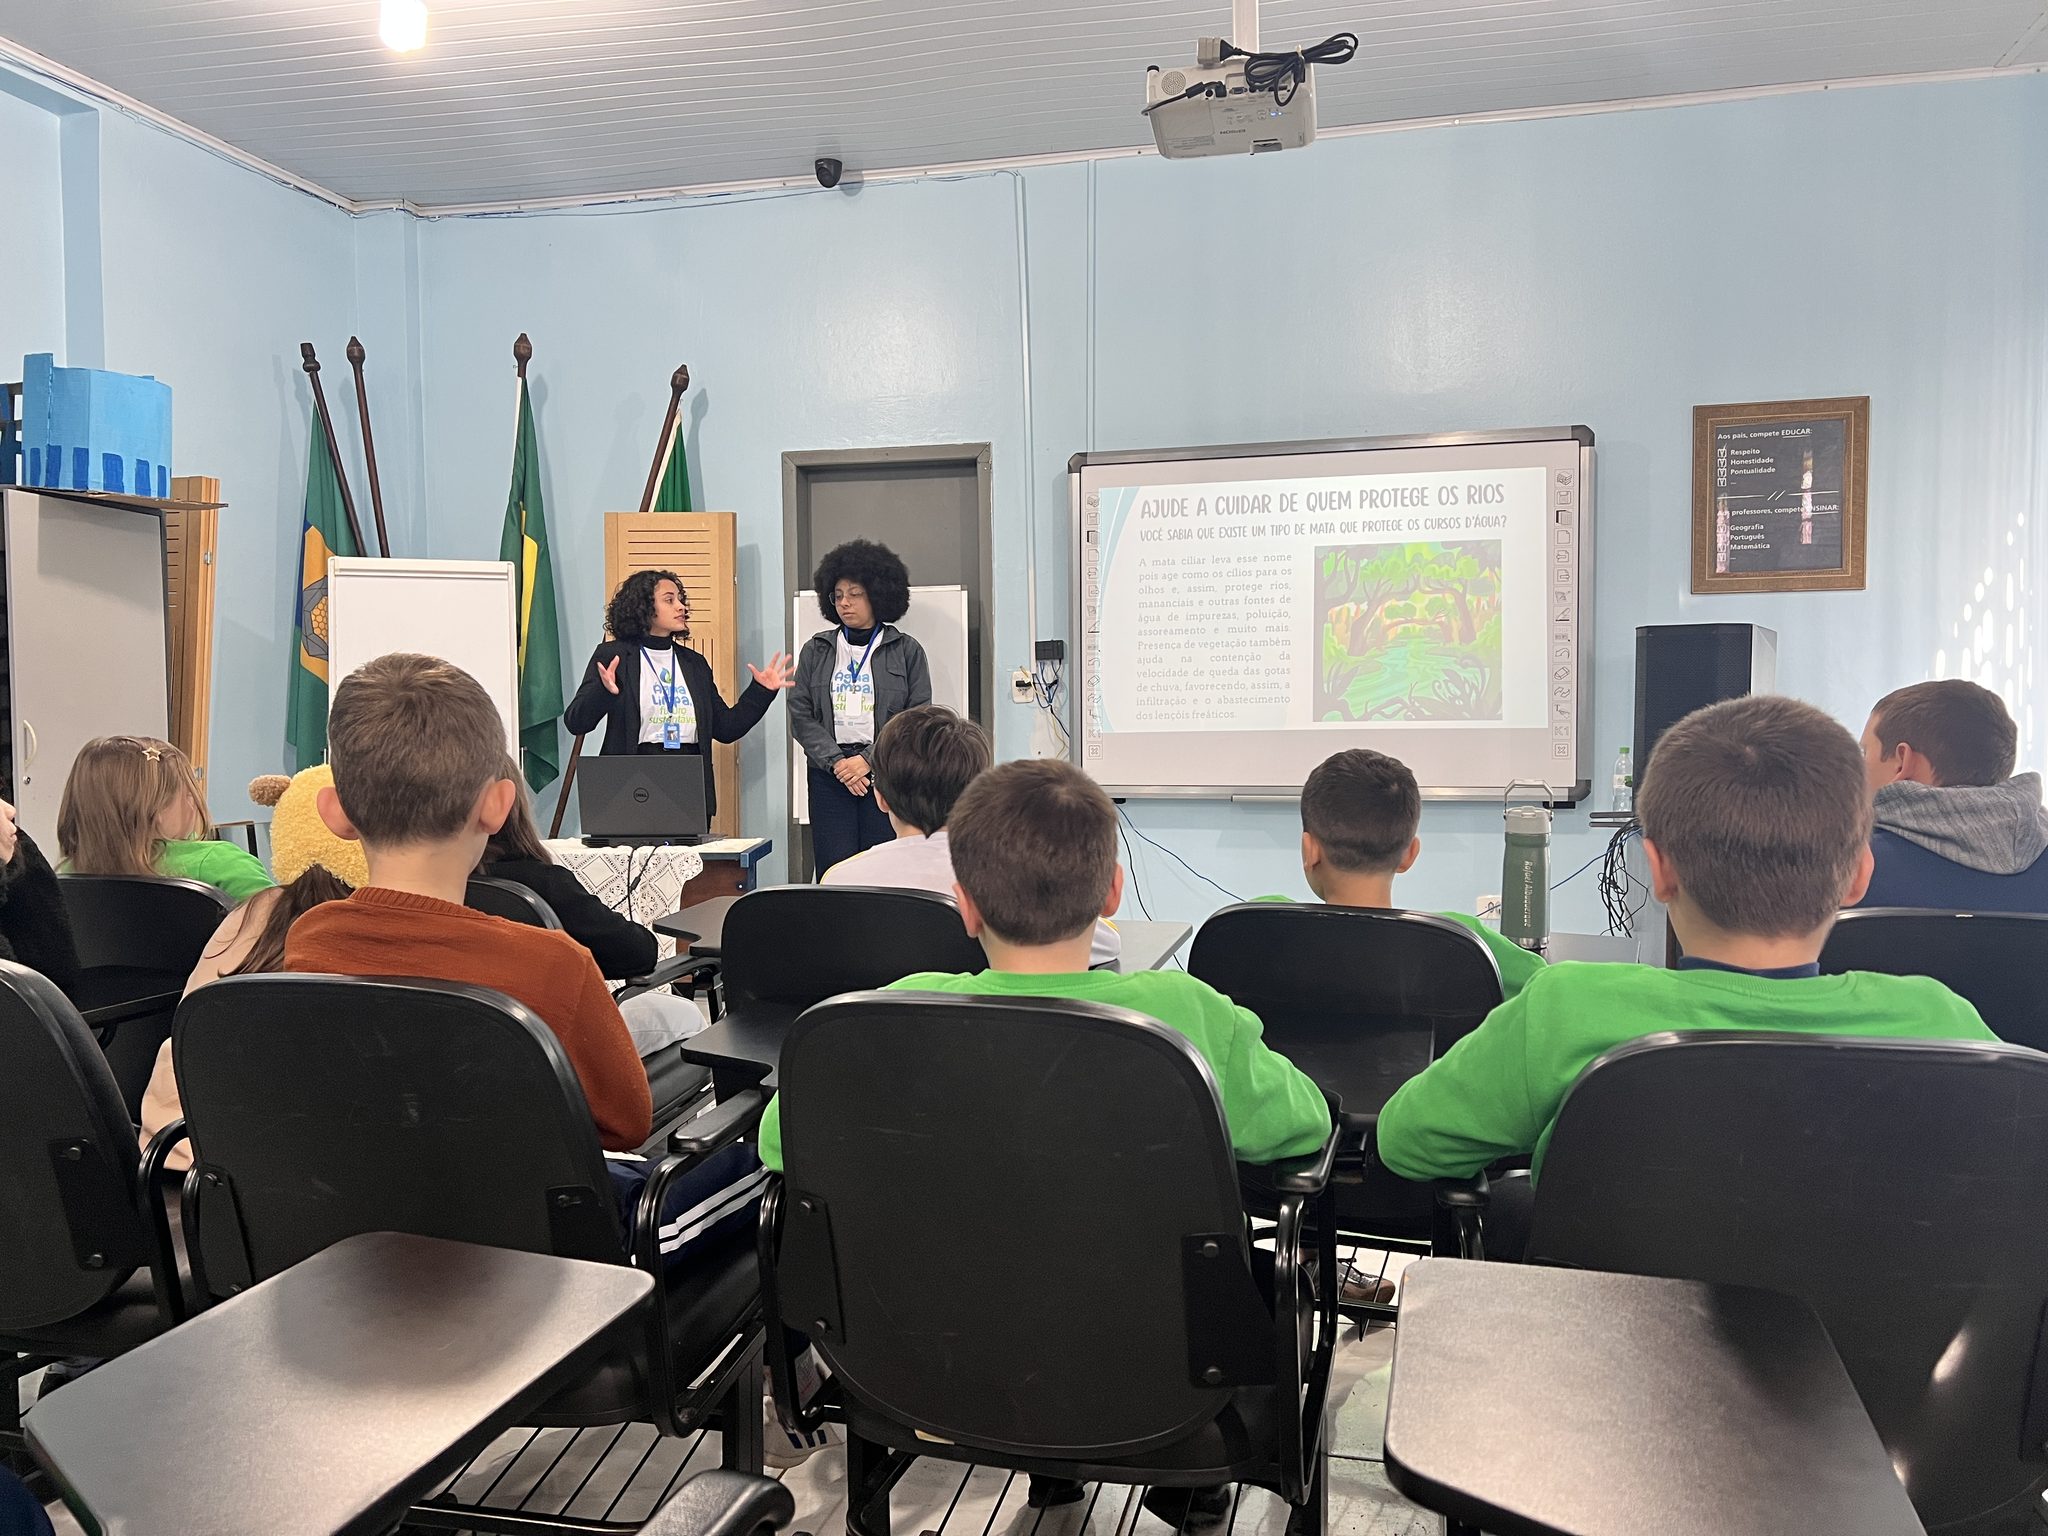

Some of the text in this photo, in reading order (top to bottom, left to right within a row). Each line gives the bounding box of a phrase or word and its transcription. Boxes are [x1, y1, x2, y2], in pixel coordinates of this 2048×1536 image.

[1732, 432, 1748, 440] pais,
[1782, 428, 1812, 436] EDUCAR:
[1731, 457, 1774, 465] Honestidade
[1731, 467, 1776, 475] Pontualidade
[1141, 484, 1504, 519] AJUDE A CUIDAR DE QUEM PROTEGE OS RIOS
[1732, 508, 1772, 516] professores,
[1167, 528, 1193, 540] SABIA
[1197, 527, 1215, 540] QUE
[1219, 526, 1247, 539] EXISTE
[1252, 525, 1266, 537] UM
[1270, 524, 1290, 536] TIPO
[1294, 523, 1305, 535] DE
[1310, 522, 1336, 534] MATA
[1340, 521, 1357, 534] QUE
[1362, 519, 1403, 532] PROTEGE
[1407, 519, 1420, 530] OS
[1424, 516, 1461, 530] CURSOS
[1139, 558, 1147, 567] A
[1181, 556, 1206, 565] ciliar
[1211, 555, 1231, 564] leva
[1237, 555, 1258, 563] esse
[1263, 554, 1292, 562] nome
[1139, 572, 1158, 583] pois
[1162, 572, 1178, 582] age
[1182, 571, 1209, 579] como
[1212, 570, 1223, 578] os
[1256, 568, 1277, 578] para
[1281, 568, 1292, 576] os
[1138, 585, 1164, 595] olhos
[1225, 583, 1262, 593] protege
[1138, 598, 1194, 609] mananciais
[1208, 597, 1239, 606] outras
[1244, 596, 1275, 605] fontes
[1279, 595, 1291, 604] de
[1167, 612, 1179, 622] de
[1186, 612, 1239, 623] impurezas,
[1246, 609, 1291, 620] poluição,
[1138, 626, 1206, 636] assoreamento
[1214, 626, 1219, 634] e
[1227, 624, 1257, 634] muito
[1138, 637, 1291, 650] Presença de vegetação também
[1137, 655, 1163, 665] ajuda
[1210, 653, 1261, 663] contenção
[1279, 651, 1290, 661] da
[1137, 666, 1290, 678] velocidade de queda das gotas
[1136, 683, 1148, 692] de
[1150, 683, 1182, 692] chuva,
[1185, 681, 1248, 691] favorecendo,
[1251, 680, 1282, 690] assim,
[1136, 696, 1186, 707] infiltração
[1192, 697, 1198, 705] e
[1217, 695, 1290, 705] abastecimento
[1136, 711, 1152, 720] dos
[1154, 710, 1190, 721] lençóis
[1523, 861, 1533, 883] Rafael
